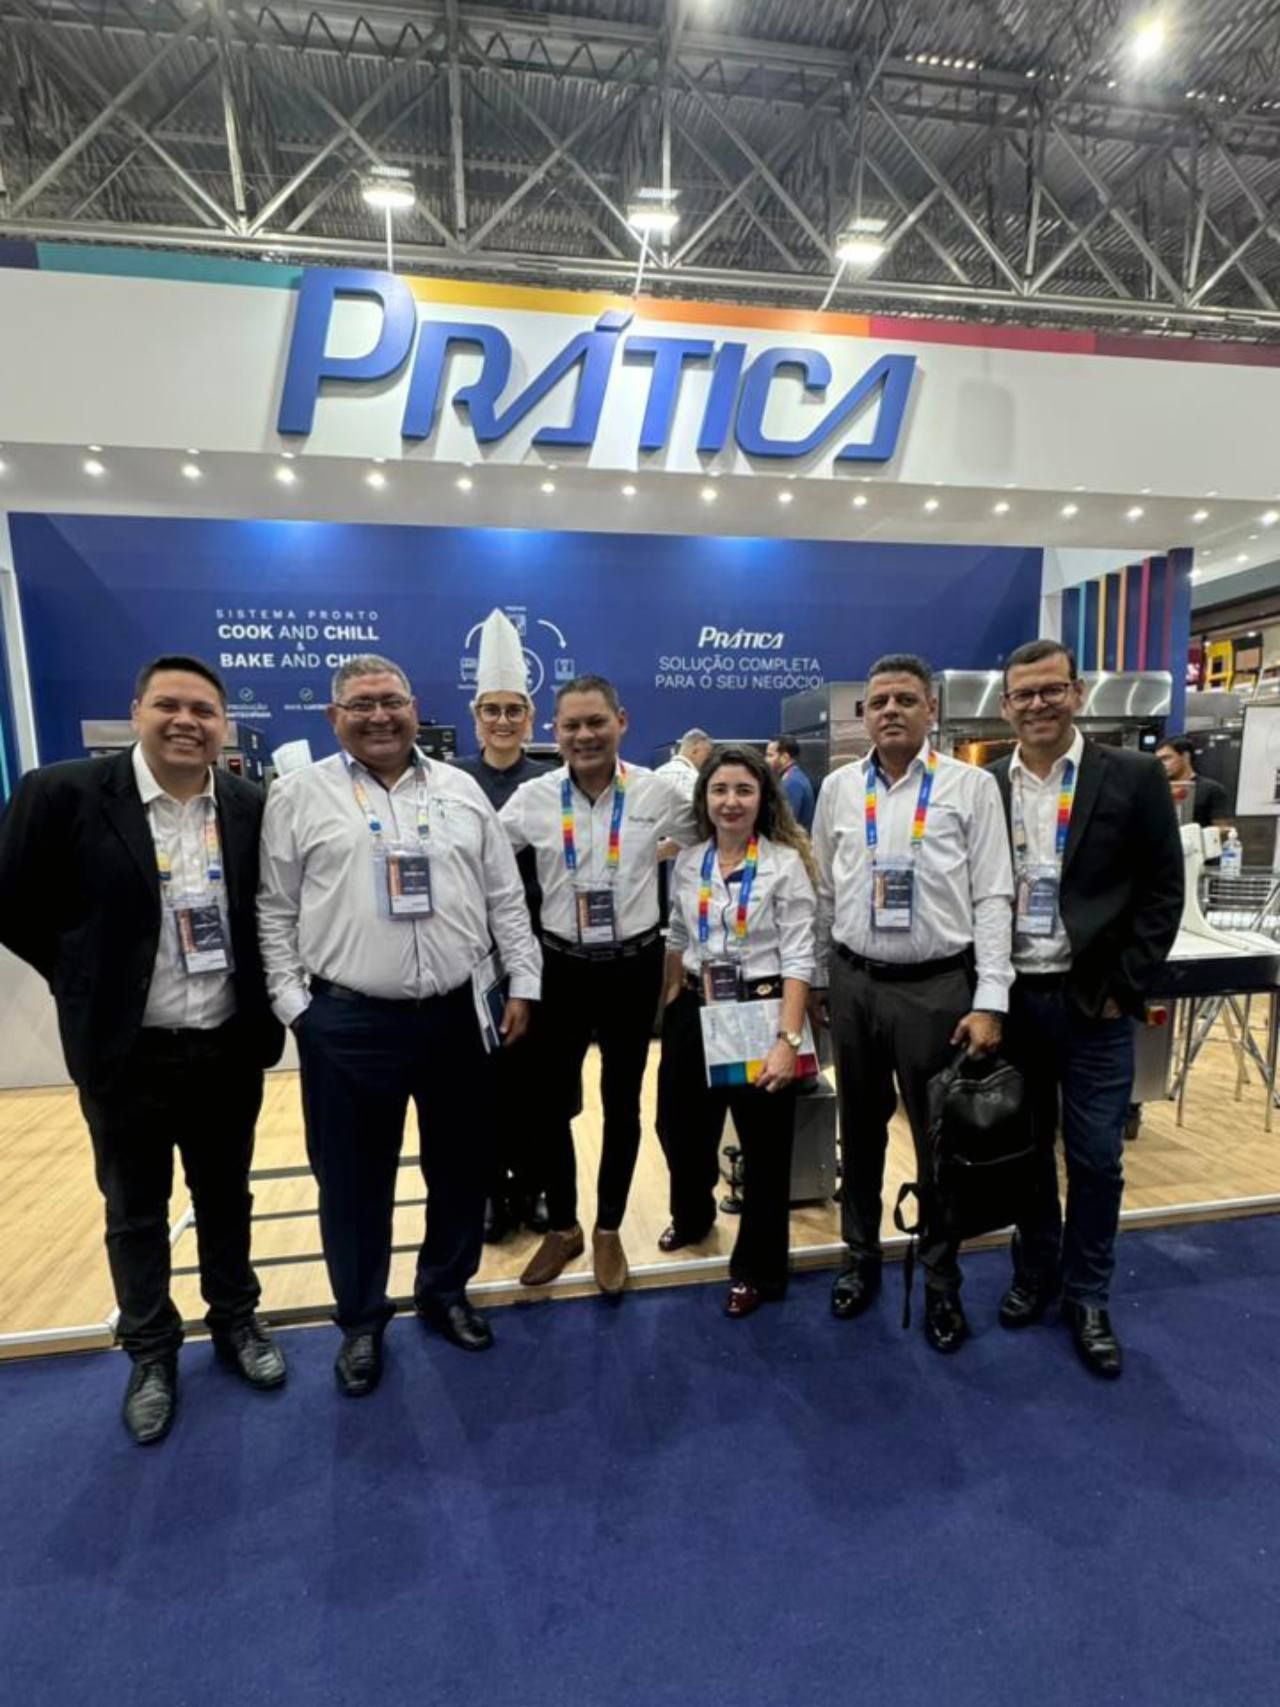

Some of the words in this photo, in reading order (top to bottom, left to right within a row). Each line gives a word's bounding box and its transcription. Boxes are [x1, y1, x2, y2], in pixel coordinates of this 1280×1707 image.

[277, 267, 917, 462] PRÁTICA
[216, 609, 296, 620] SISTEMA
[308, 610, 378, 621] PRONTO
[218, 624, 274, 640] COOK
[279, 625, 319, 640] AND
[324, 625, 379, 640] CHILL
[220, 653, 275, 668] BAKE
[281, 653, 321, 668] AND
[659, 655, 734, 673] SOLUÇÃO
[739, 657, 820, 671] COMPLETA
[655, 675, 695, 688] PARA
[700, 675, 712, 688] O
[716, 675, 747, 689] SEU
